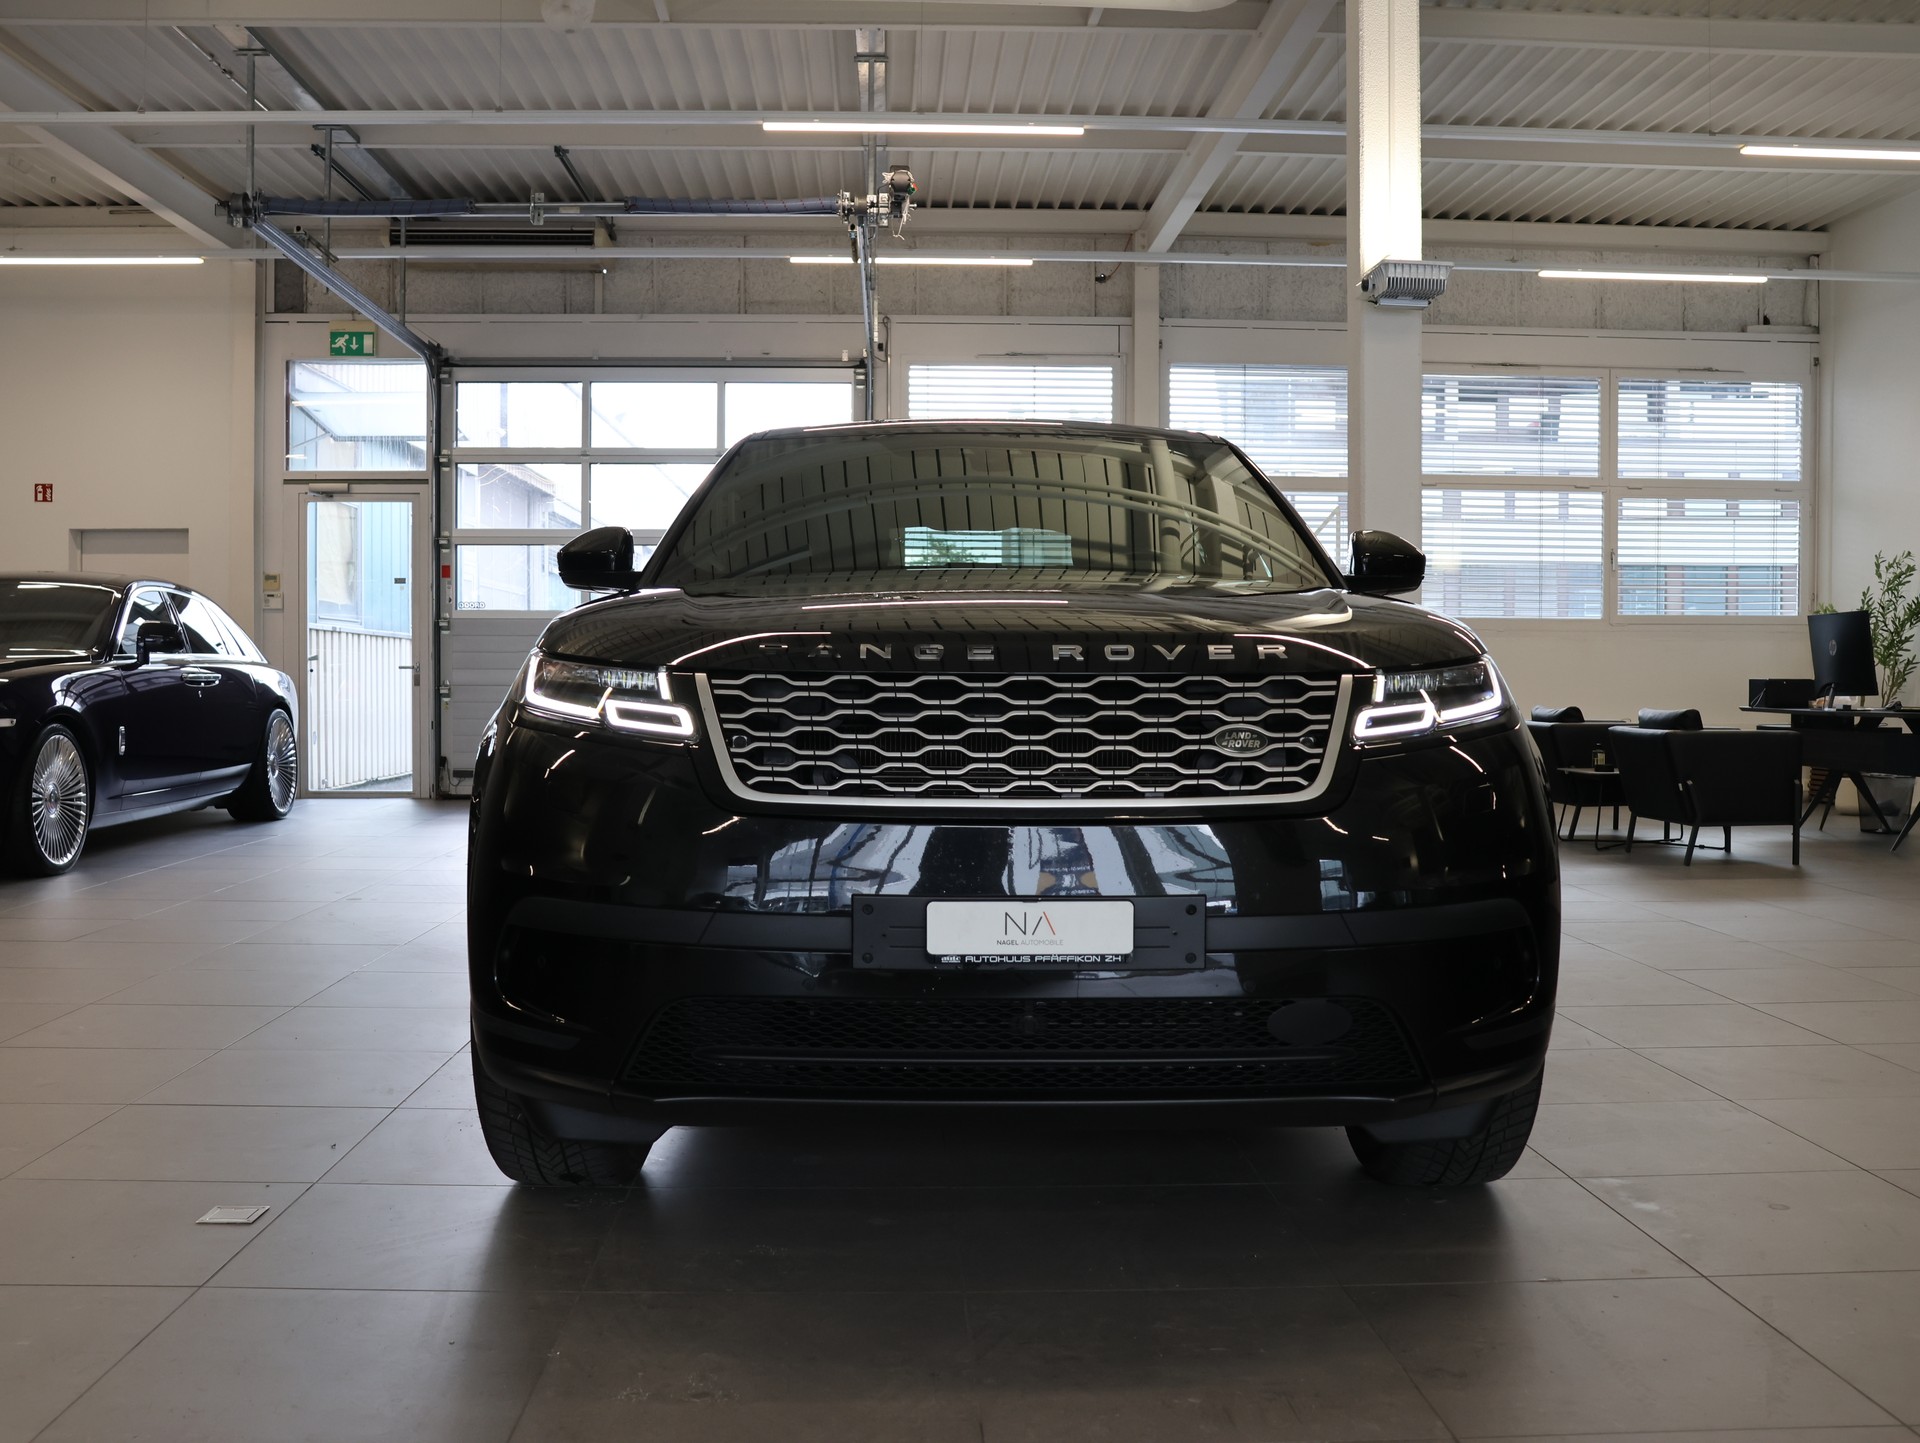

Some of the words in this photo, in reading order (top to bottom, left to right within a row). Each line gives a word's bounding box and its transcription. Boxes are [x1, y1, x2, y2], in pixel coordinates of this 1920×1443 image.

[1051, 644, 1289, 661] ROVER
[1224, 731, 1252, 740] LAND
[1227, 740, 1261, 748] ROVER
[1004, 911, 1056, 936] NA
[965, 955, 1031, 963] AUTOHUUS
[1034, 953, 1101, 963] PFÄFFIKON
[1104, 955, 1122, 963] ZH
